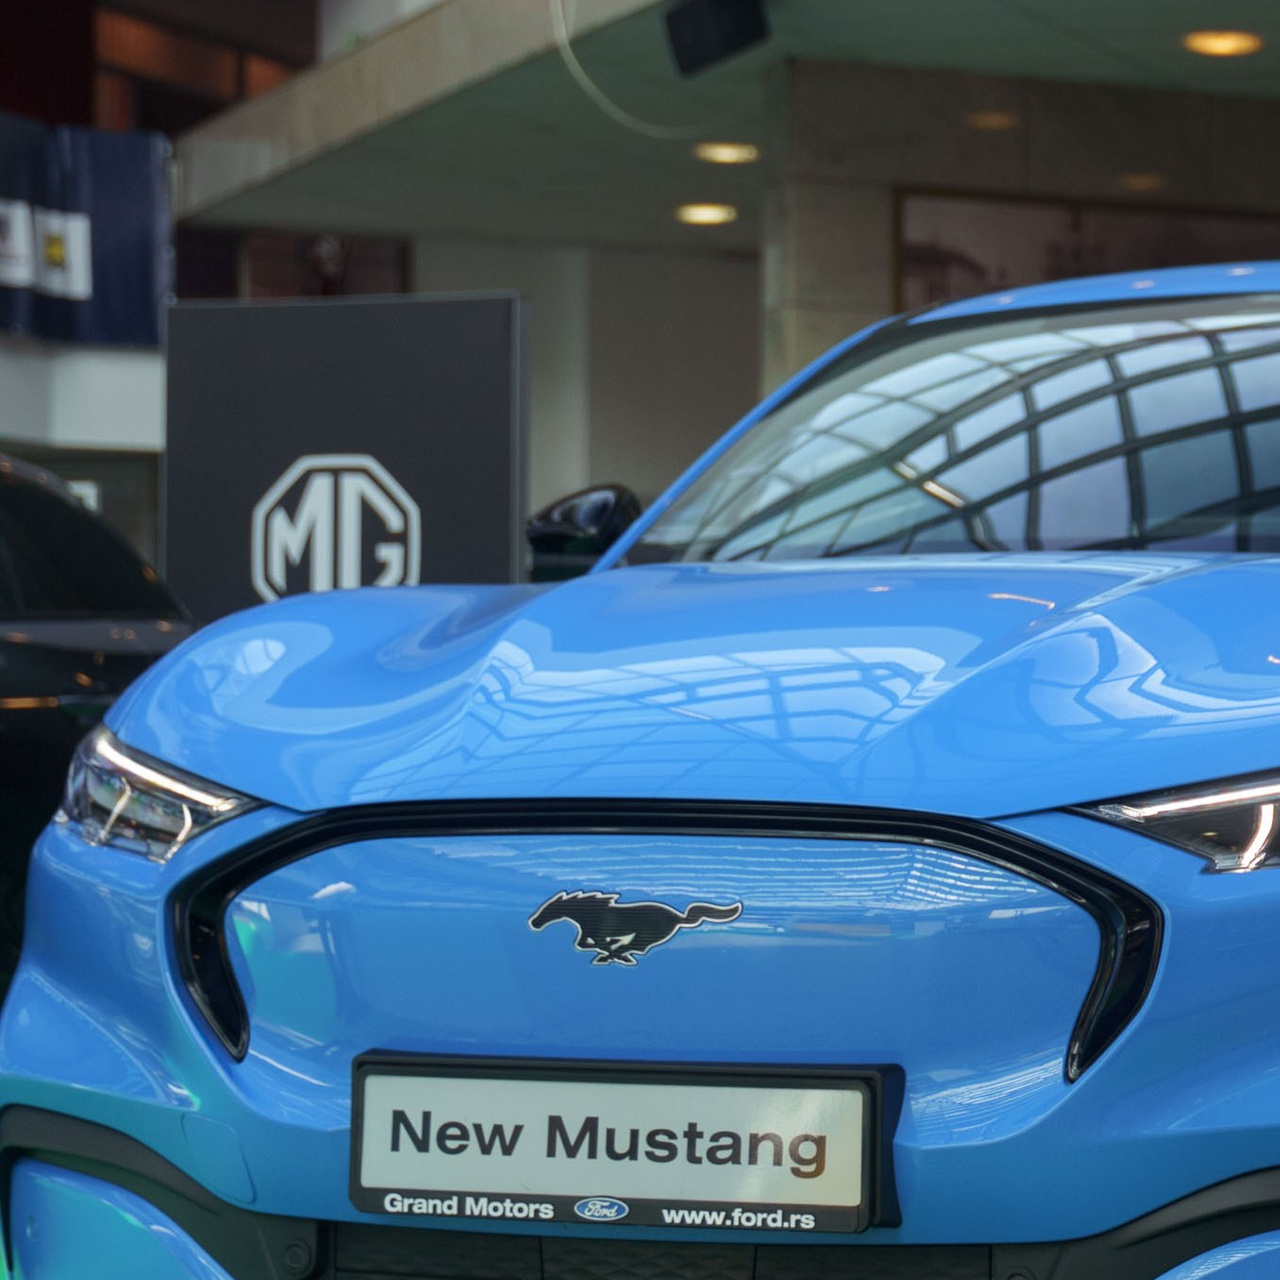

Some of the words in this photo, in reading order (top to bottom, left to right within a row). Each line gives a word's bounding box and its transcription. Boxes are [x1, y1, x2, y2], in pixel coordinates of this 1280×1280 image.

[267, 471, 407, 593] MG
[390, 1109, 524, 1157] New
[546, 1115, 827, 1179] Mustang
[383, 1193, 458, 1215] Grand
[464, 1196, 555, 1219] Motors
[582, 1199, 619, 1219] Ford
[662, 1207, 816, 1229] www.ford.rs
